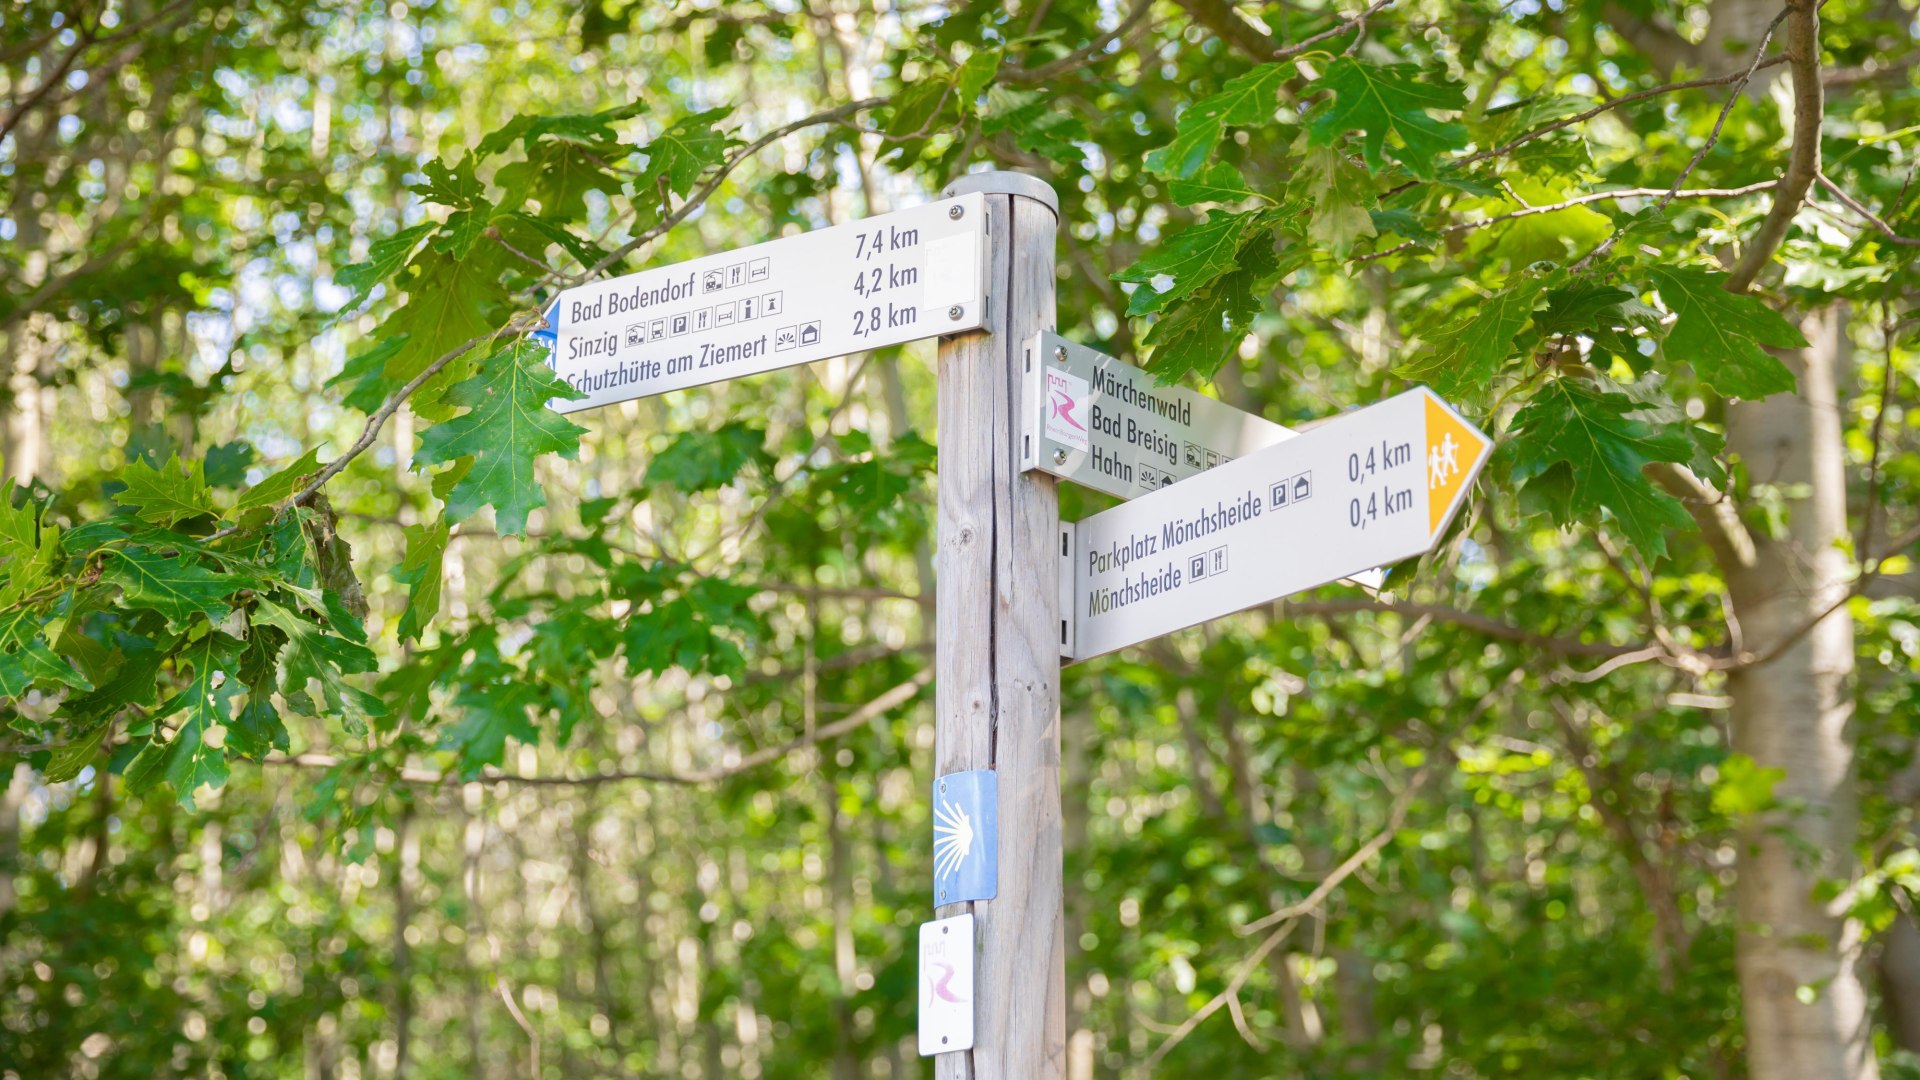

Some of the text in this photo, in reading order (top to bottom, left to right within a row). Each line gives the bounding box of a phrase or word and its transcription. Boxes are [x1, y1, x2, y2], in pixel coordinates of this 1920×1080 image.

[856, 225, 918, 261] 7,4 km
[571, 272, 695, 324] Bad Bodendorf
[854, 263, 917, 299] 4,2 km
[853, 302, 916, 338] 2,8 km
[569, 331, 618, 360] Sinzig
[667, 354, 693, 375] am
[699, 335, 767, 368] Ziemert
[1092, 365, 1190, 427] Märchenwald
[1092, 404, 1177, 465] Bad Breisig
[1092, 444, 1132, 483] Hahn
[1349, 440, 1411, 485] 0,4 km
[1350, 485, 1412, 530] 0,4 km
[1089, 534, 1157, 576] Parkplatz
[1162, 490, 1262, 551] Mönchsheide
[1089, 562, 1182, 618] Mönchsheide
